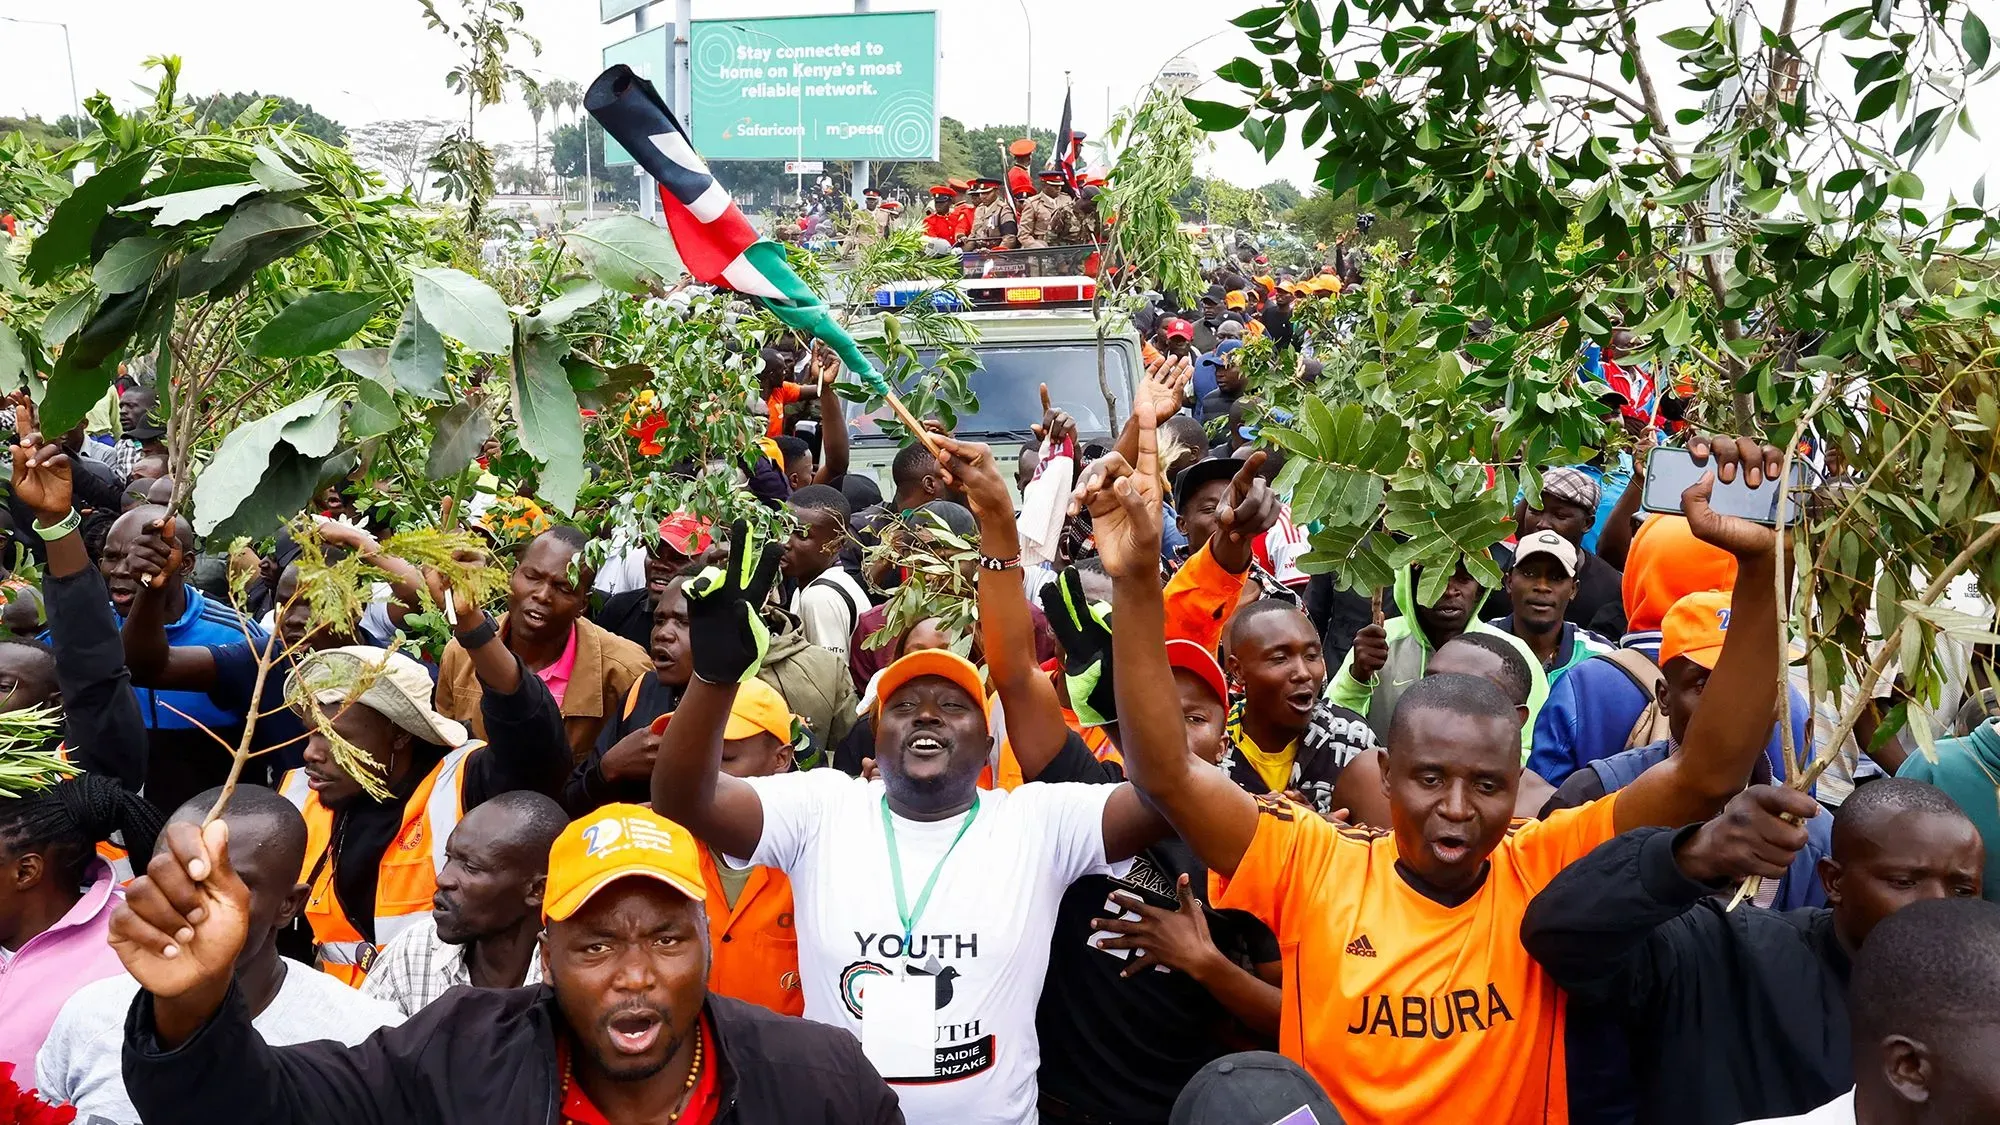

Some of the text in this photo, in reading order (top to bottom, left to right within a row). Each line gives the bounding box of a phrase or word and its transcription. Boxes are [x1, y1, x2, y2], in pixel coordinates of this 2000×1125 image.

[736, 41, 884, 62] Stay connected to
[720, 61, 902, 80] home on Kenya's most
[742, 81, 877, 98] reliable network.
[737, 123, 805, 136] Safaricom
[854, 931, 977, 958] YOUTH
[1346, 946, 1377, 958] adidas
[1348, 982, 1514, 1039] JABURA
[935, 1045, 980, 1062] SAIDIE
[935, 1056, 987, 1076] ENZAKE
